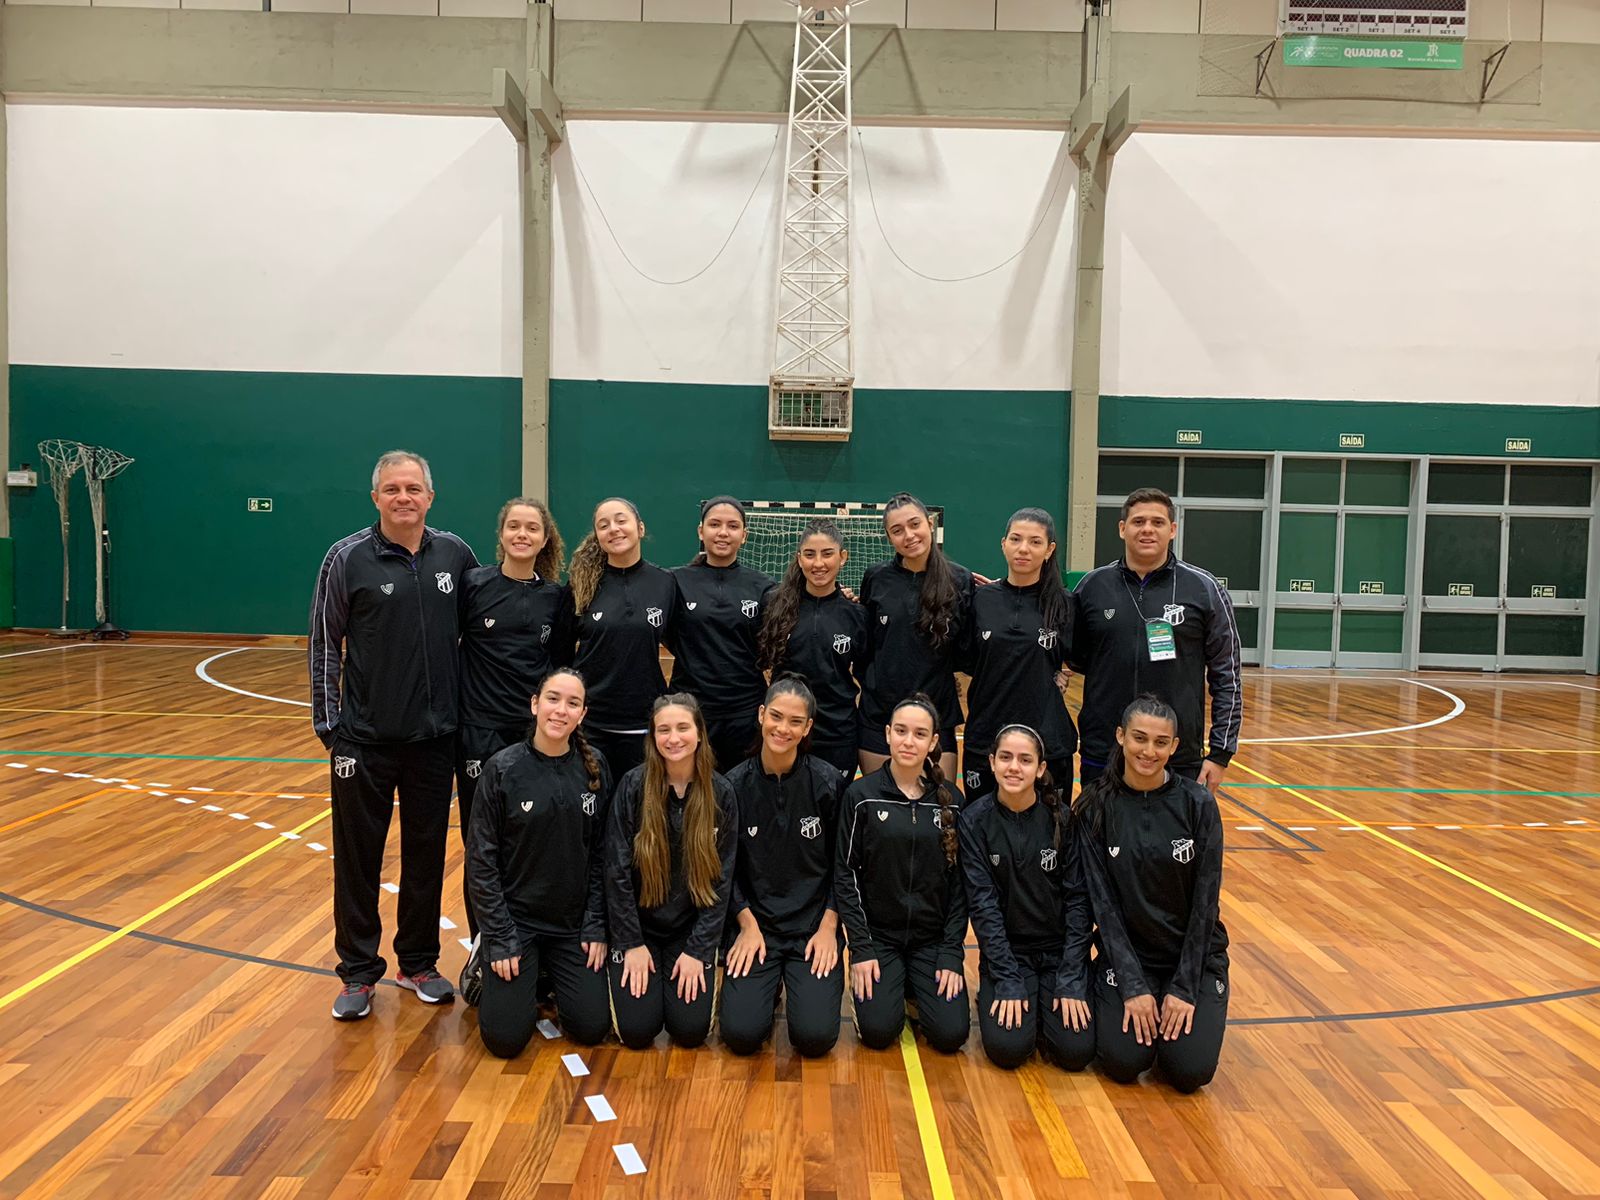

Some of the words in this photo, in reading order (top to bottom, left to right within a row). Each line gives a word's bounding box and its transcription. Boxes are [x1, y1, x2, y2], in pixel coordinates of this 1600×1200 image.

[1344, 47, 1388, 58] QUADRA
[1389, 48, 1404, 58] 02
[1342, 434, 1362, 444] SAÍDA
